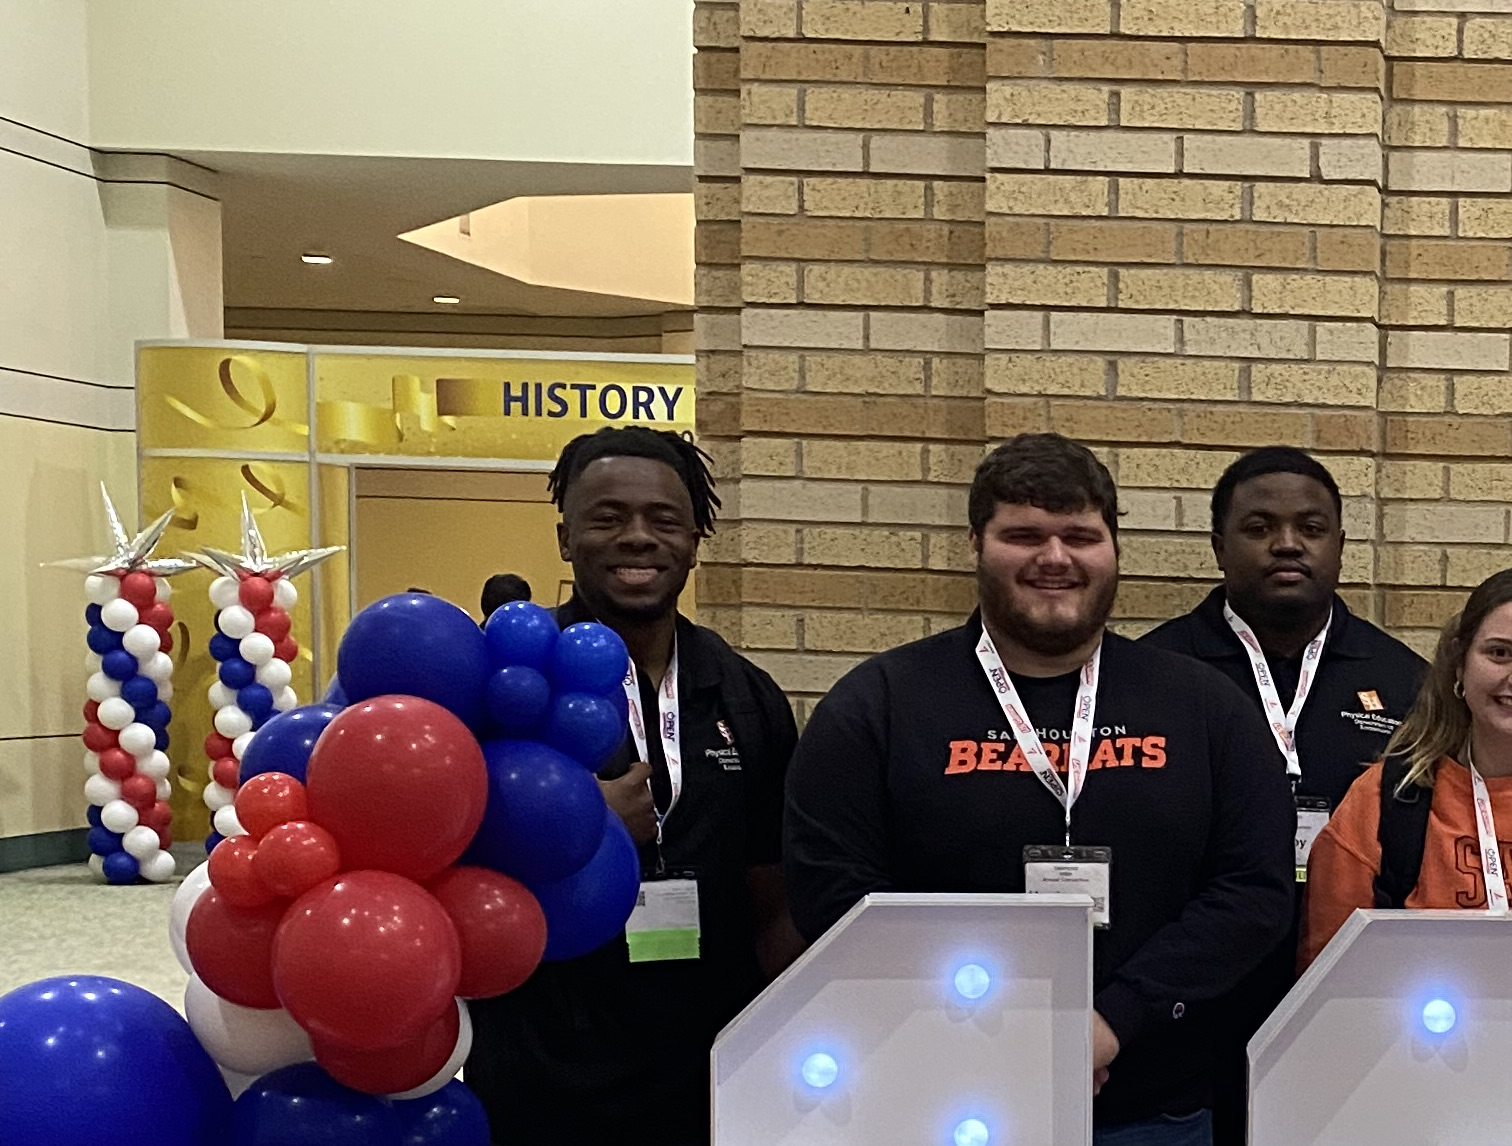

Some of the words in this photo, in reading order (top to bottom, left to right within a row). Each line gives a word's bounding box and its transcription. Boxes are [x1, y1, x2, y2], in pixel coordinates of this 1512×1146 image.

[503, 381, 684, 421] HISTORY
[989, 668, 1007, 694] OPEN
[1082, 695, 1092, 723] OPEN
[667, 711, 675, 742] OPEN
[1036, 725, 1127, 741] HOUTON
[1040, 769, 1065, 797] OPEN
[1488, 848, 1498, 877] OPEN
